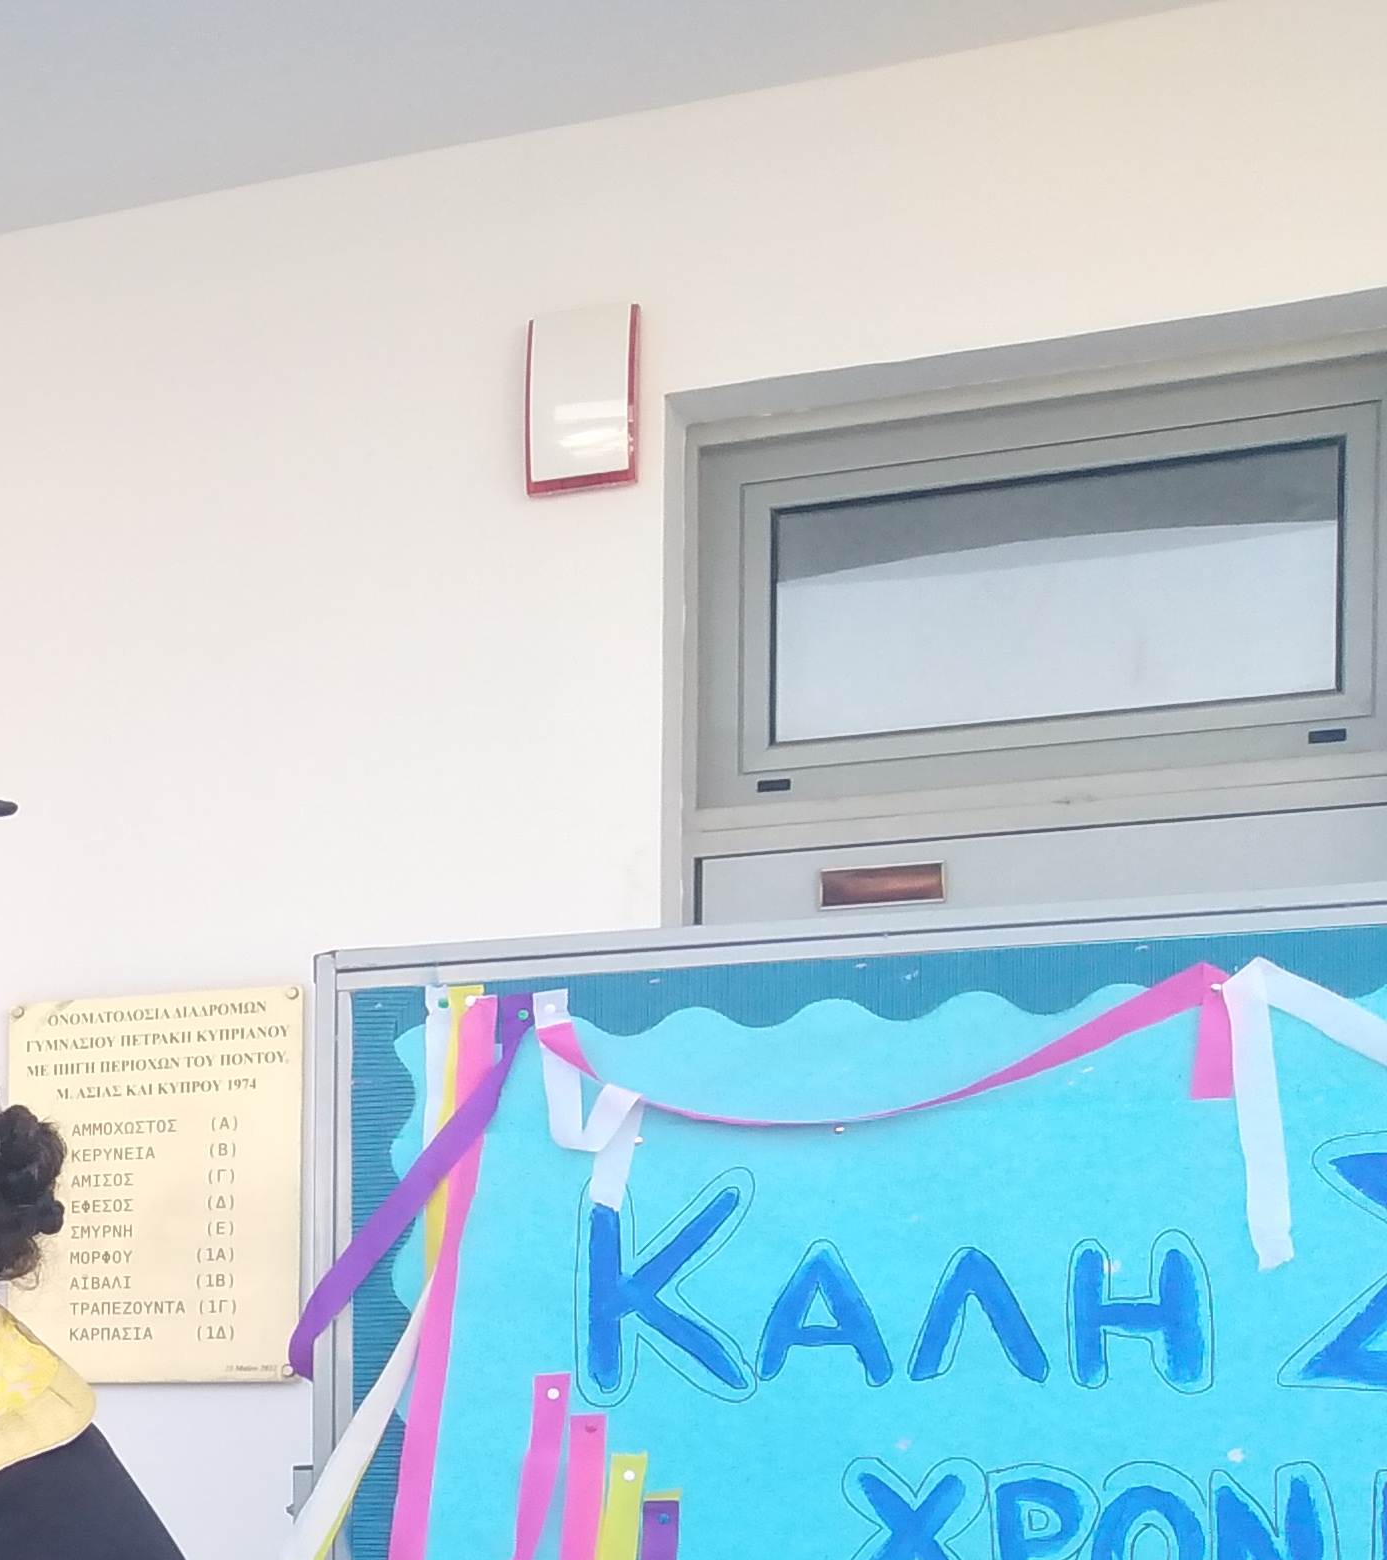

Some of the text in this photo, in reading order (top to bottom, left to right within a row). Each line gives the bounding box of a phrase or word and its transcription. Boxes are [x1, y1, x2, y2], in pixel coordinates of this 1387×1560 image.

[47, 1000, 267, 1027] ΟΝΟΜΑΤΟΔΟΣΙΑ ΔΙΑΔΡΟΜΩΝ
[26, 1024, 290, 1053] ΓΥΜΝΑΣΙΟΥ ΠΕΤΡΑΚΗ ΚΥΠΡΙΑΝΟΥ
[26, 1064, 50, 1077] ΜΕ
[53, 1061, 96, 1076] ΠΗΓΗ
[100, 1057, 180, 1074] ΠΕΡΙΟΧΩΝ
[184, 1054, 215, 1069] ΤΟΥ
[56, 1077, 257, 1101] Μ. ΑΣΙΑΣ ΚΑΙ ΚΥΠΡΟΥ 1974
[71, 1115, 239, 1137] ΑΜΜΟΧΩΣΤΟΣ (Α)
[70, 1142, 237, 1163] ΚΕΡΥΝΕΙΑ (Β)
[70, 1168, 236, 1188] ΑΜΙΣΟΣ (Γ)
[70, 1194, 235, 1214] ΕΦΕΣΟΣ (Δ)
[69, 1220, 235, 1240] ΣΜΥΡΝΗ (Ε)
[69, 1246, 235, 1265] ΜΟΡΦΟΥ (1Α)
[69, 1272, 235, 1291] ΑΪΒΑΛΙ (1Β)
[577, 1167, 1213, 1406] ΚΑΛΗ
[69, 1299, 237, 1316] ΤΡΑΠΕΖΟΥΝΤΑ (1Γ)
[69, 1325, 235, 1342] ΚΑΡΠΑΣΙΑ (1Δ)
